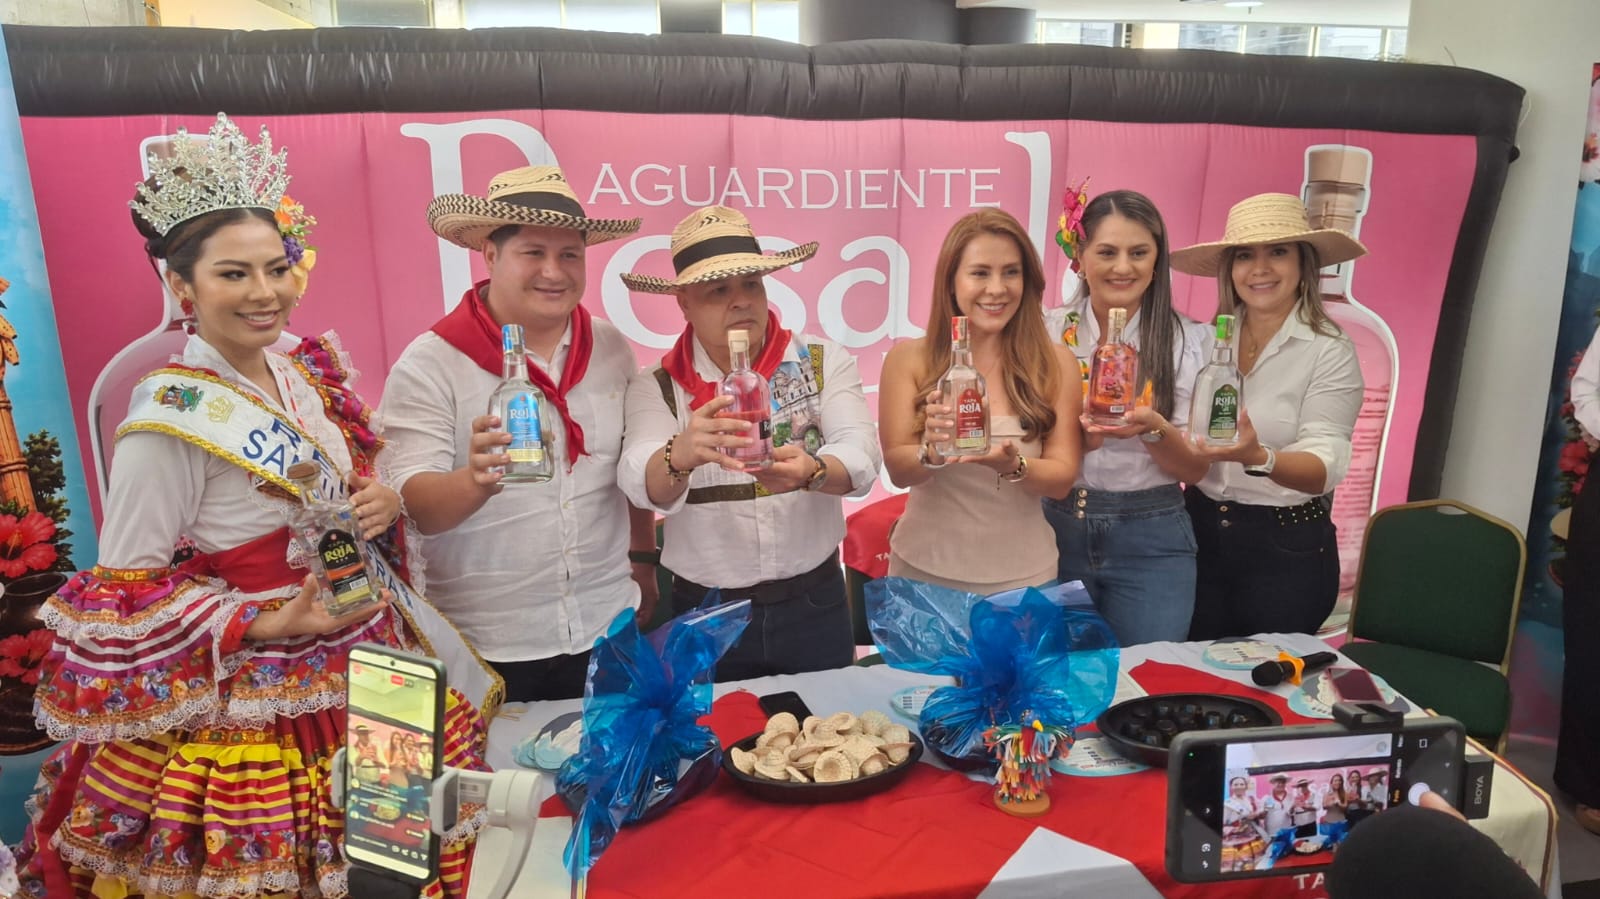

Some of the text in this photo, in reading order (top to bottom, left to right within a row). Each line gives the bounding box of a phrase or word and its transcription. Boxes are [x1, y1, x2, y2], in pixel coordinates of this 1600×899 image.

[587, 163, 1000, 209] AGUARDIENTE
[960, 402, 981, 413] ROJA
[324, 543, 355, 562] ROJA
[1474, 775, 1484, 804] BOYA
